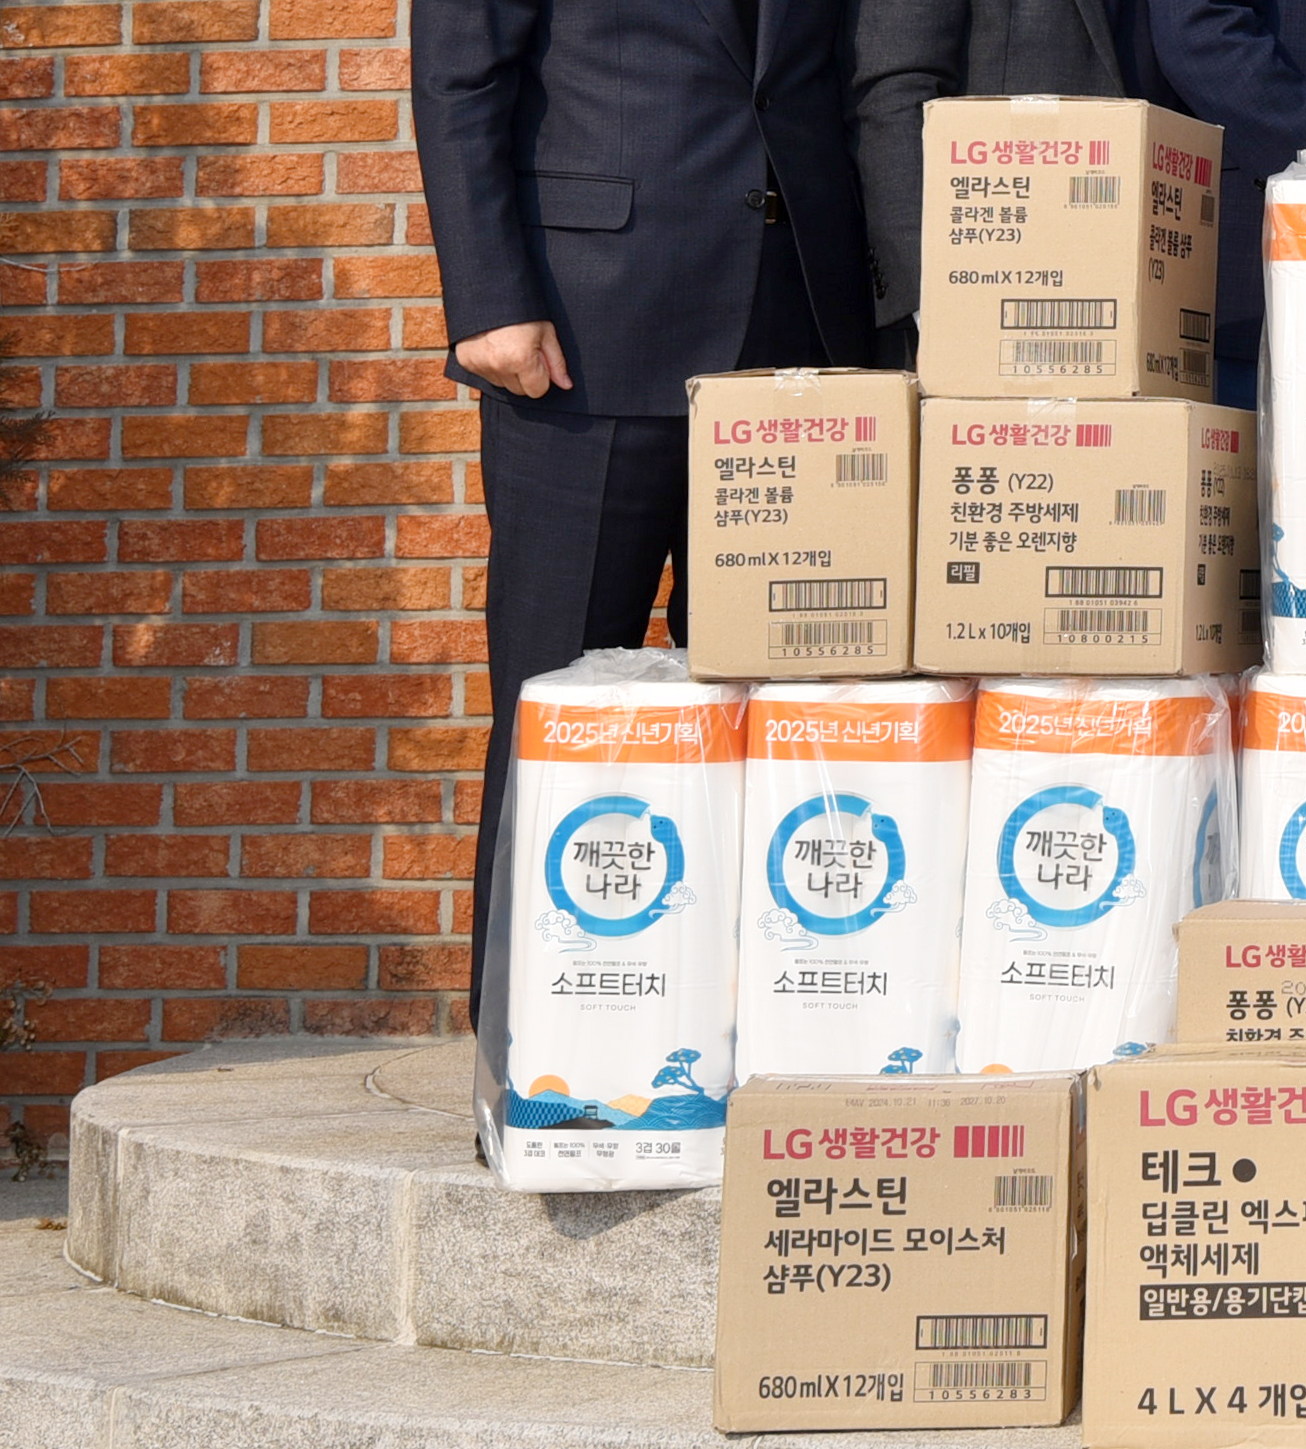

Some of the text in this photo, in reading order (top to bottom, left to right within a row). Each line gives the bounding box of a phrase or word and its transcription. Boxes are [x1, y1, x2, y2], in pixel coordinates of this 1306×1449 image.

[951, 140, 1082, 165] LG 생활건강
[950, 176, 1031, 199] 엘라스틴
[950, 206, 1028, 224] 콜라겐 볼륨
[714, 418, 848, 444] LG 생활건강
[952, 424, 1070, 447] LG 생활건강
[714, 456, 796, 480] 엘라스틴
[951, 466, 1054, 495] 퐁퐁 (Y22)
[714, 486, 794, 505] 콜라겐 볼륨
[950, 502, 1078, 524] 친환경 주방세제
[950, 532, 1076, 552] 기분 좋은 오렌지향
[950, 565, 976, 580] 리필
[543, 720, 699, 746] 2025년 신년기획
[765, 720, 919, 745] 2025년 신년기획
[573, 841, 655, 870] 깨끗한
[794, 839, 876, 870] 깨끗한
[1026, 831, 1107, 862] 깨끗한
[585, 873, 642, 901] 나라
[807, 873, 862, 899] 나라
[1037, 864, 1093, 892] 나라
[1226, 944, 1262, 968] LG
[551, 972, 666, 996] 소프트터치
[773, 971, 887, 996] 소프트터치
[1001, 961, 1115, 989] 소프트터치
[1226, 990, 1278, 1020] 퐁퐁
[1140, 1089, 1197, 1127] LG
[763, 1128, 941, 1160] LG 생활건강
[1142, 1150, 1220, 1194] 테크
[767, 1176, 907, 1218] 엘라스틴
[1142, 1200, 1229, 1236] 딥클린
[764, 1227, 1006, 1256] 세라마이드 모이스처
[1140, 1242, 1259, 1278] 액체세제
